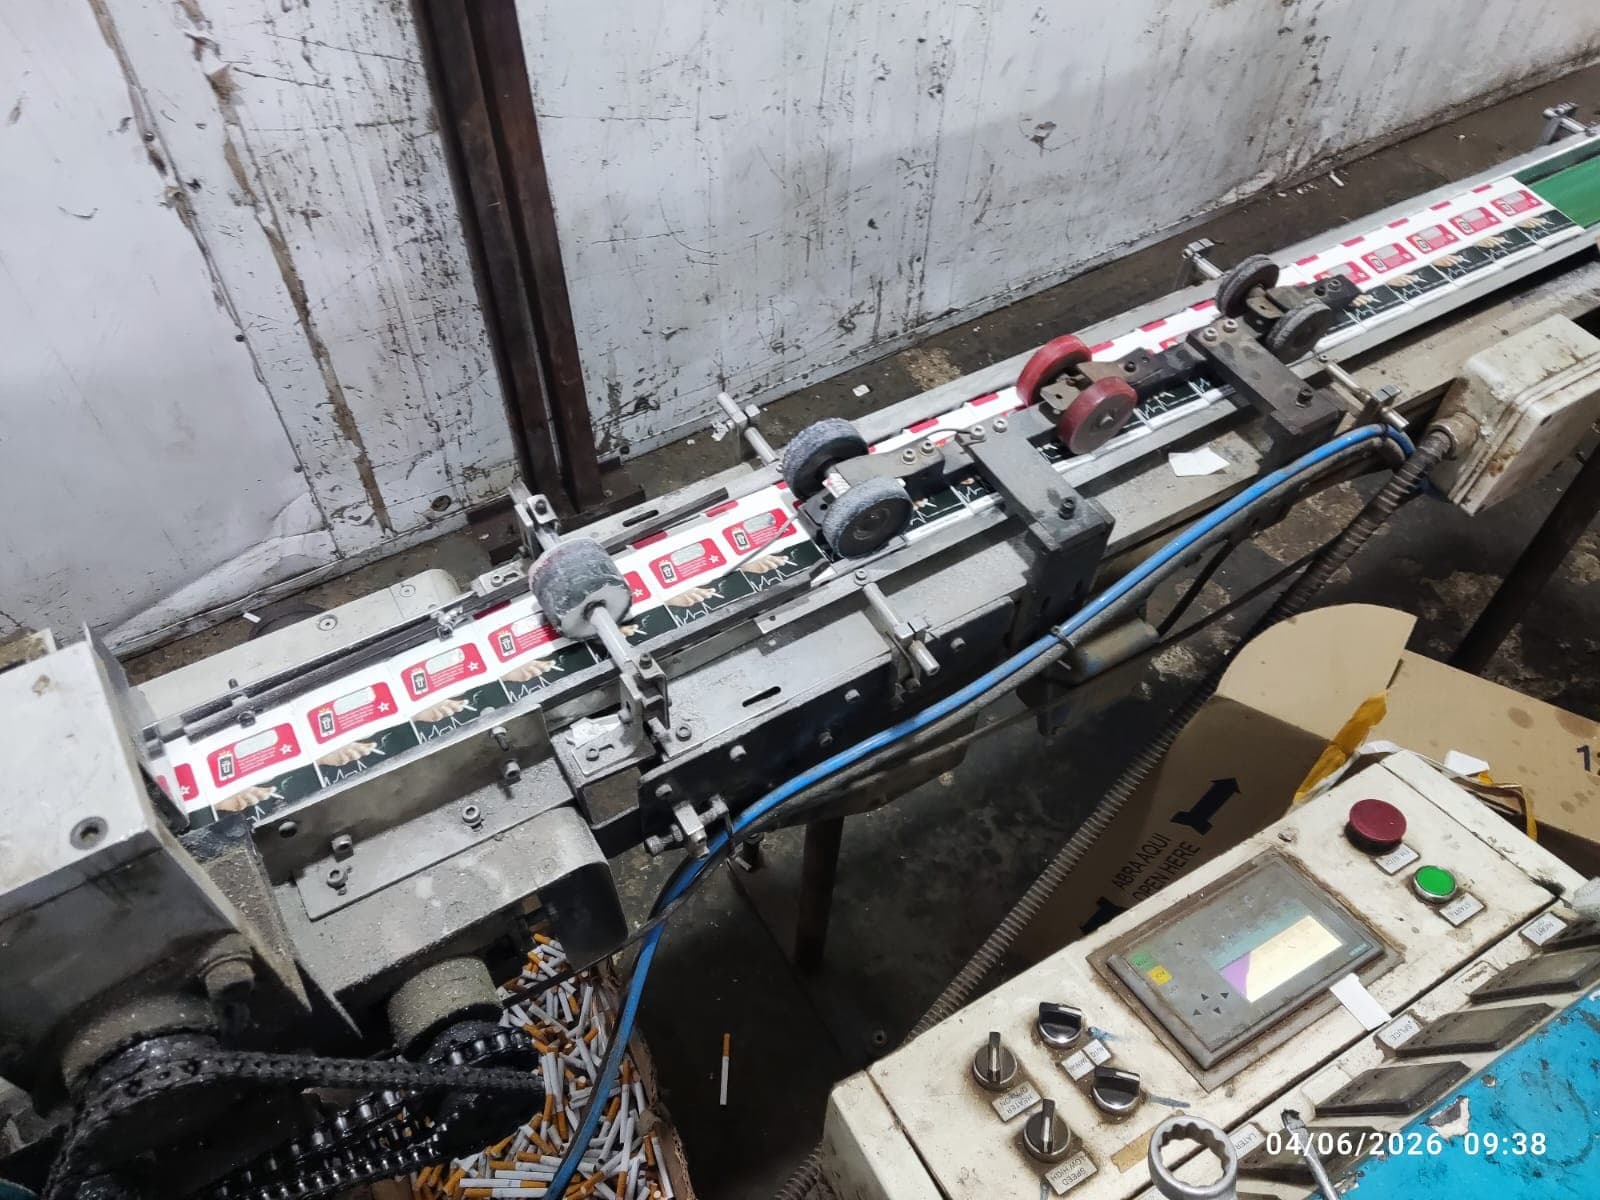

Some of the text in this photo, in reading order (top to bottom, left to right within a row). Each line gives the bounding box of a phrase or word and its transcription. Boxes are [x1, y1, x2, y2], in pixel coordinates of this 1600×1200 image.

[1576, 745, 1600, 775] 1
[1111, 832, 1171, 889] ABRA AQUI
[1132, 840, 1200, 900] OPEN HERE
[1005, 1093, 1033, 1114] HEATER
[1049, 1165, 1069, 1181] HIGH
[1061, 1167, 1086, 1186] SPEED
